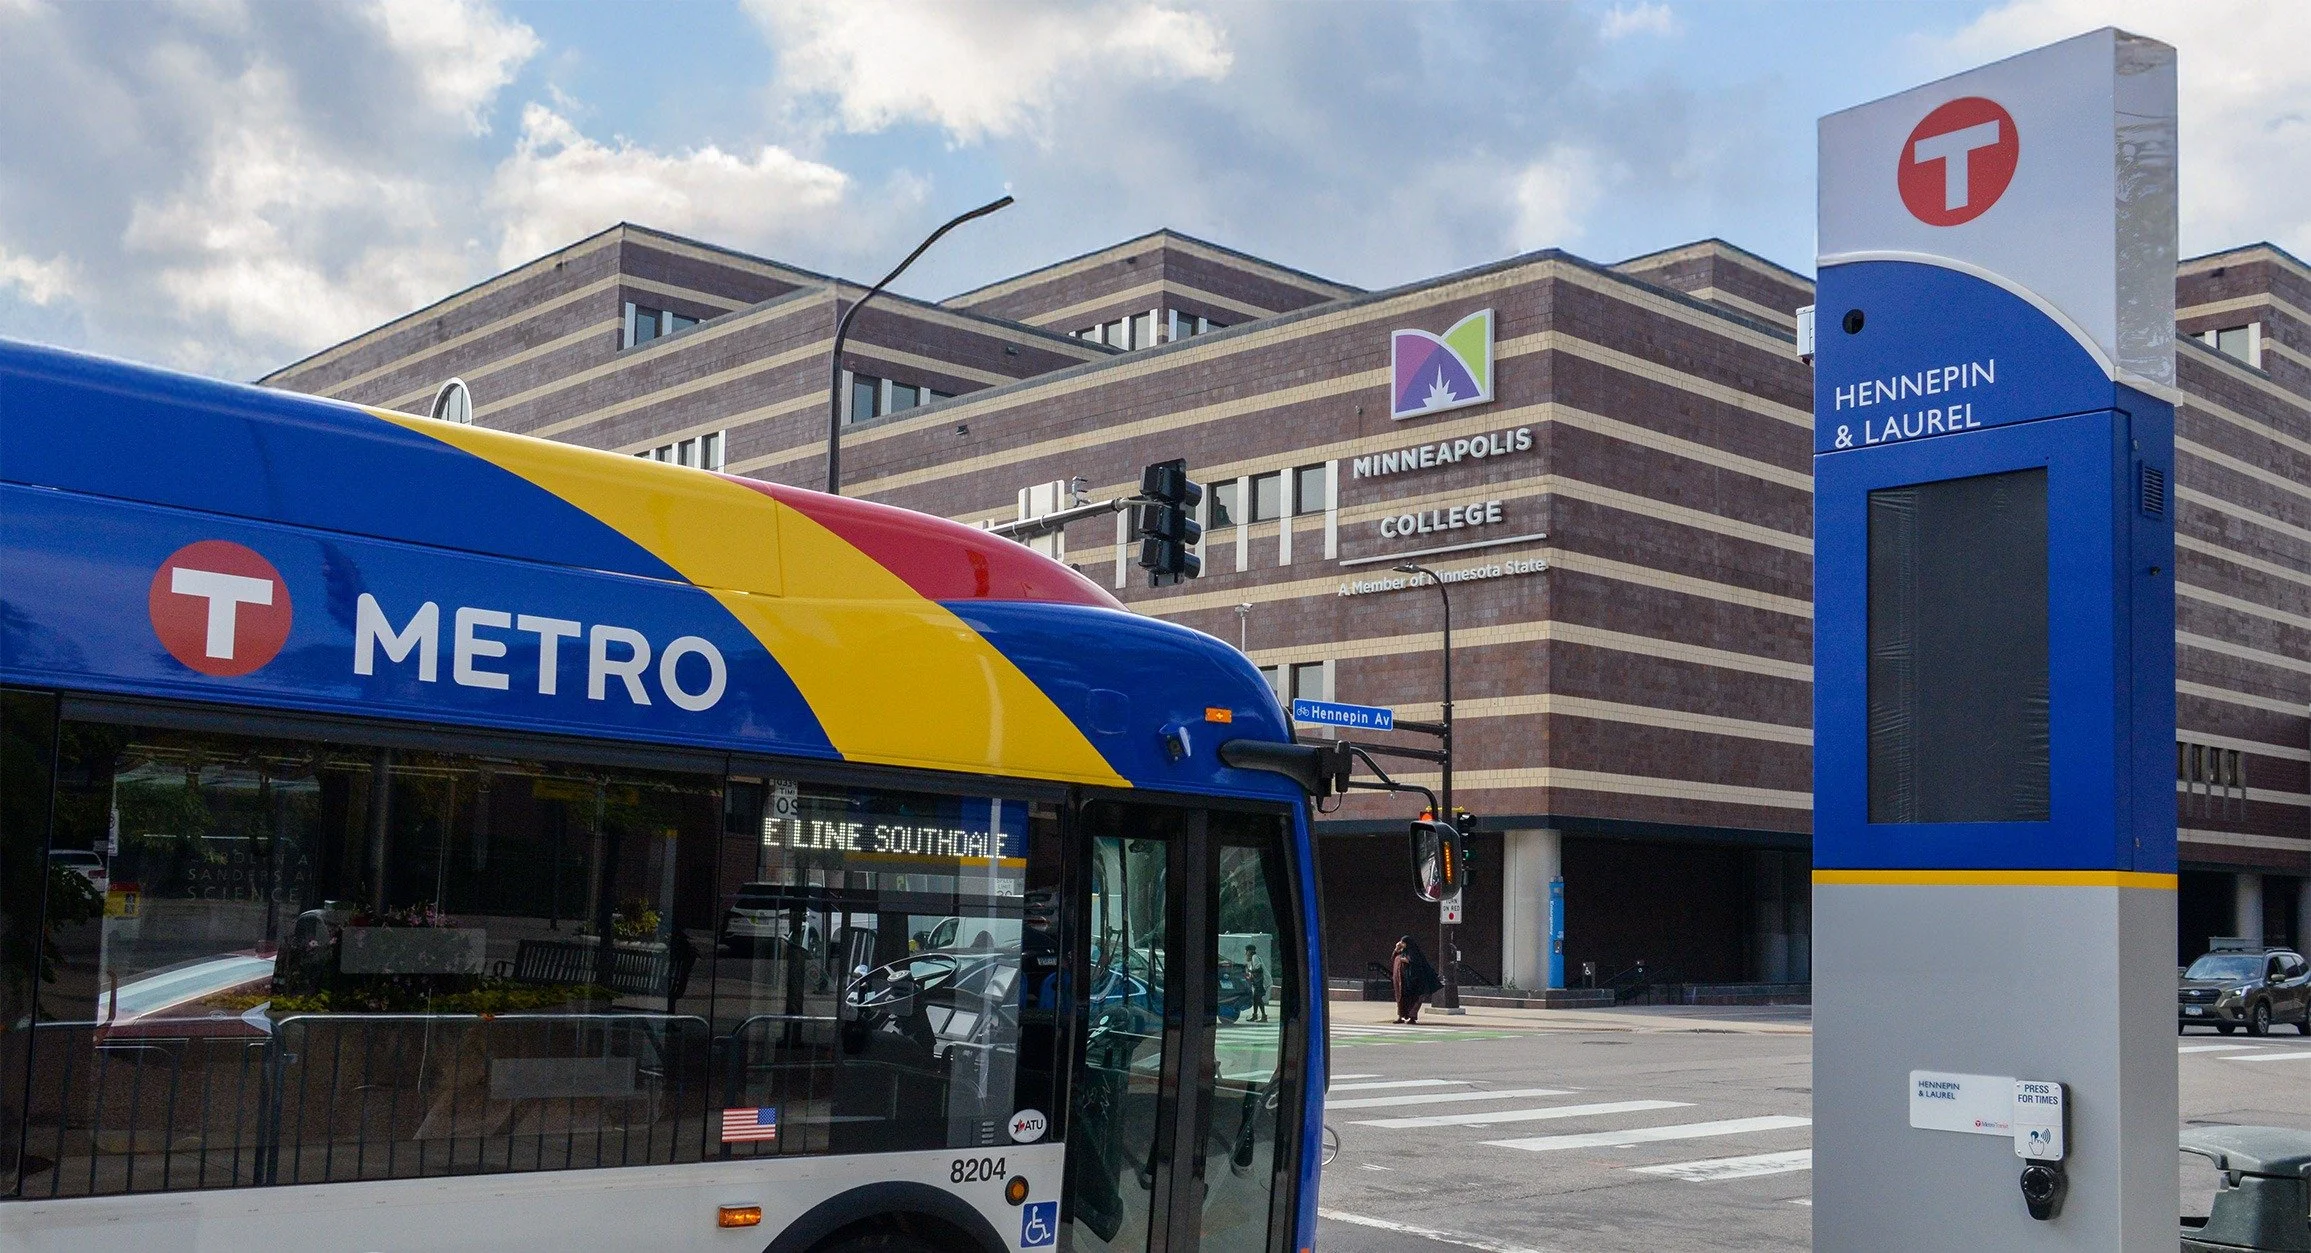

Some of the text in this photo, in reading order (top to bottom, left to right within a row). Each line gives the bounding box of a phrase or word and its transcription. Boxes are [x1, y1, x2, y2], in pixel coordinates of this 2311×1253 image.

[1913, 119, 2001, 212] T
[1834, 358, 1996, 411] HENNEPIN
[1834, 404, 1982, 449] & LAUREL
[1352, 428, 1534, 479] MINNEAPOLIS
[1380, 500, 1503, 539] COLLEGE
[1338, 583, 1351, 597] A
[1352, 573, 1408, 595] Member
[1410, 571, 1426, 587] of
[1505, 558, 1548, 576] State
[171, 567, 274, 660] T
[353, 592, 727, 712] METRO
[1311, 705, 1390, 726] Hennepin Av
[763, 817, 1008, 859] E LINE SOUTHDALE
[186, 886, 299, 905] SCIENCE
[1918, 1080, 1960, 1090] HENNEPIN
[1925, 1091, 1956, 1100] LAUREL
[2017, 1094, 2059, 1105] FOR TIMES
[2024, 1084, 2050, 1094] PRESS
[1024, 1119, 1044, 1131] ATU
[950, 1157, 1007, 1184] 8204
